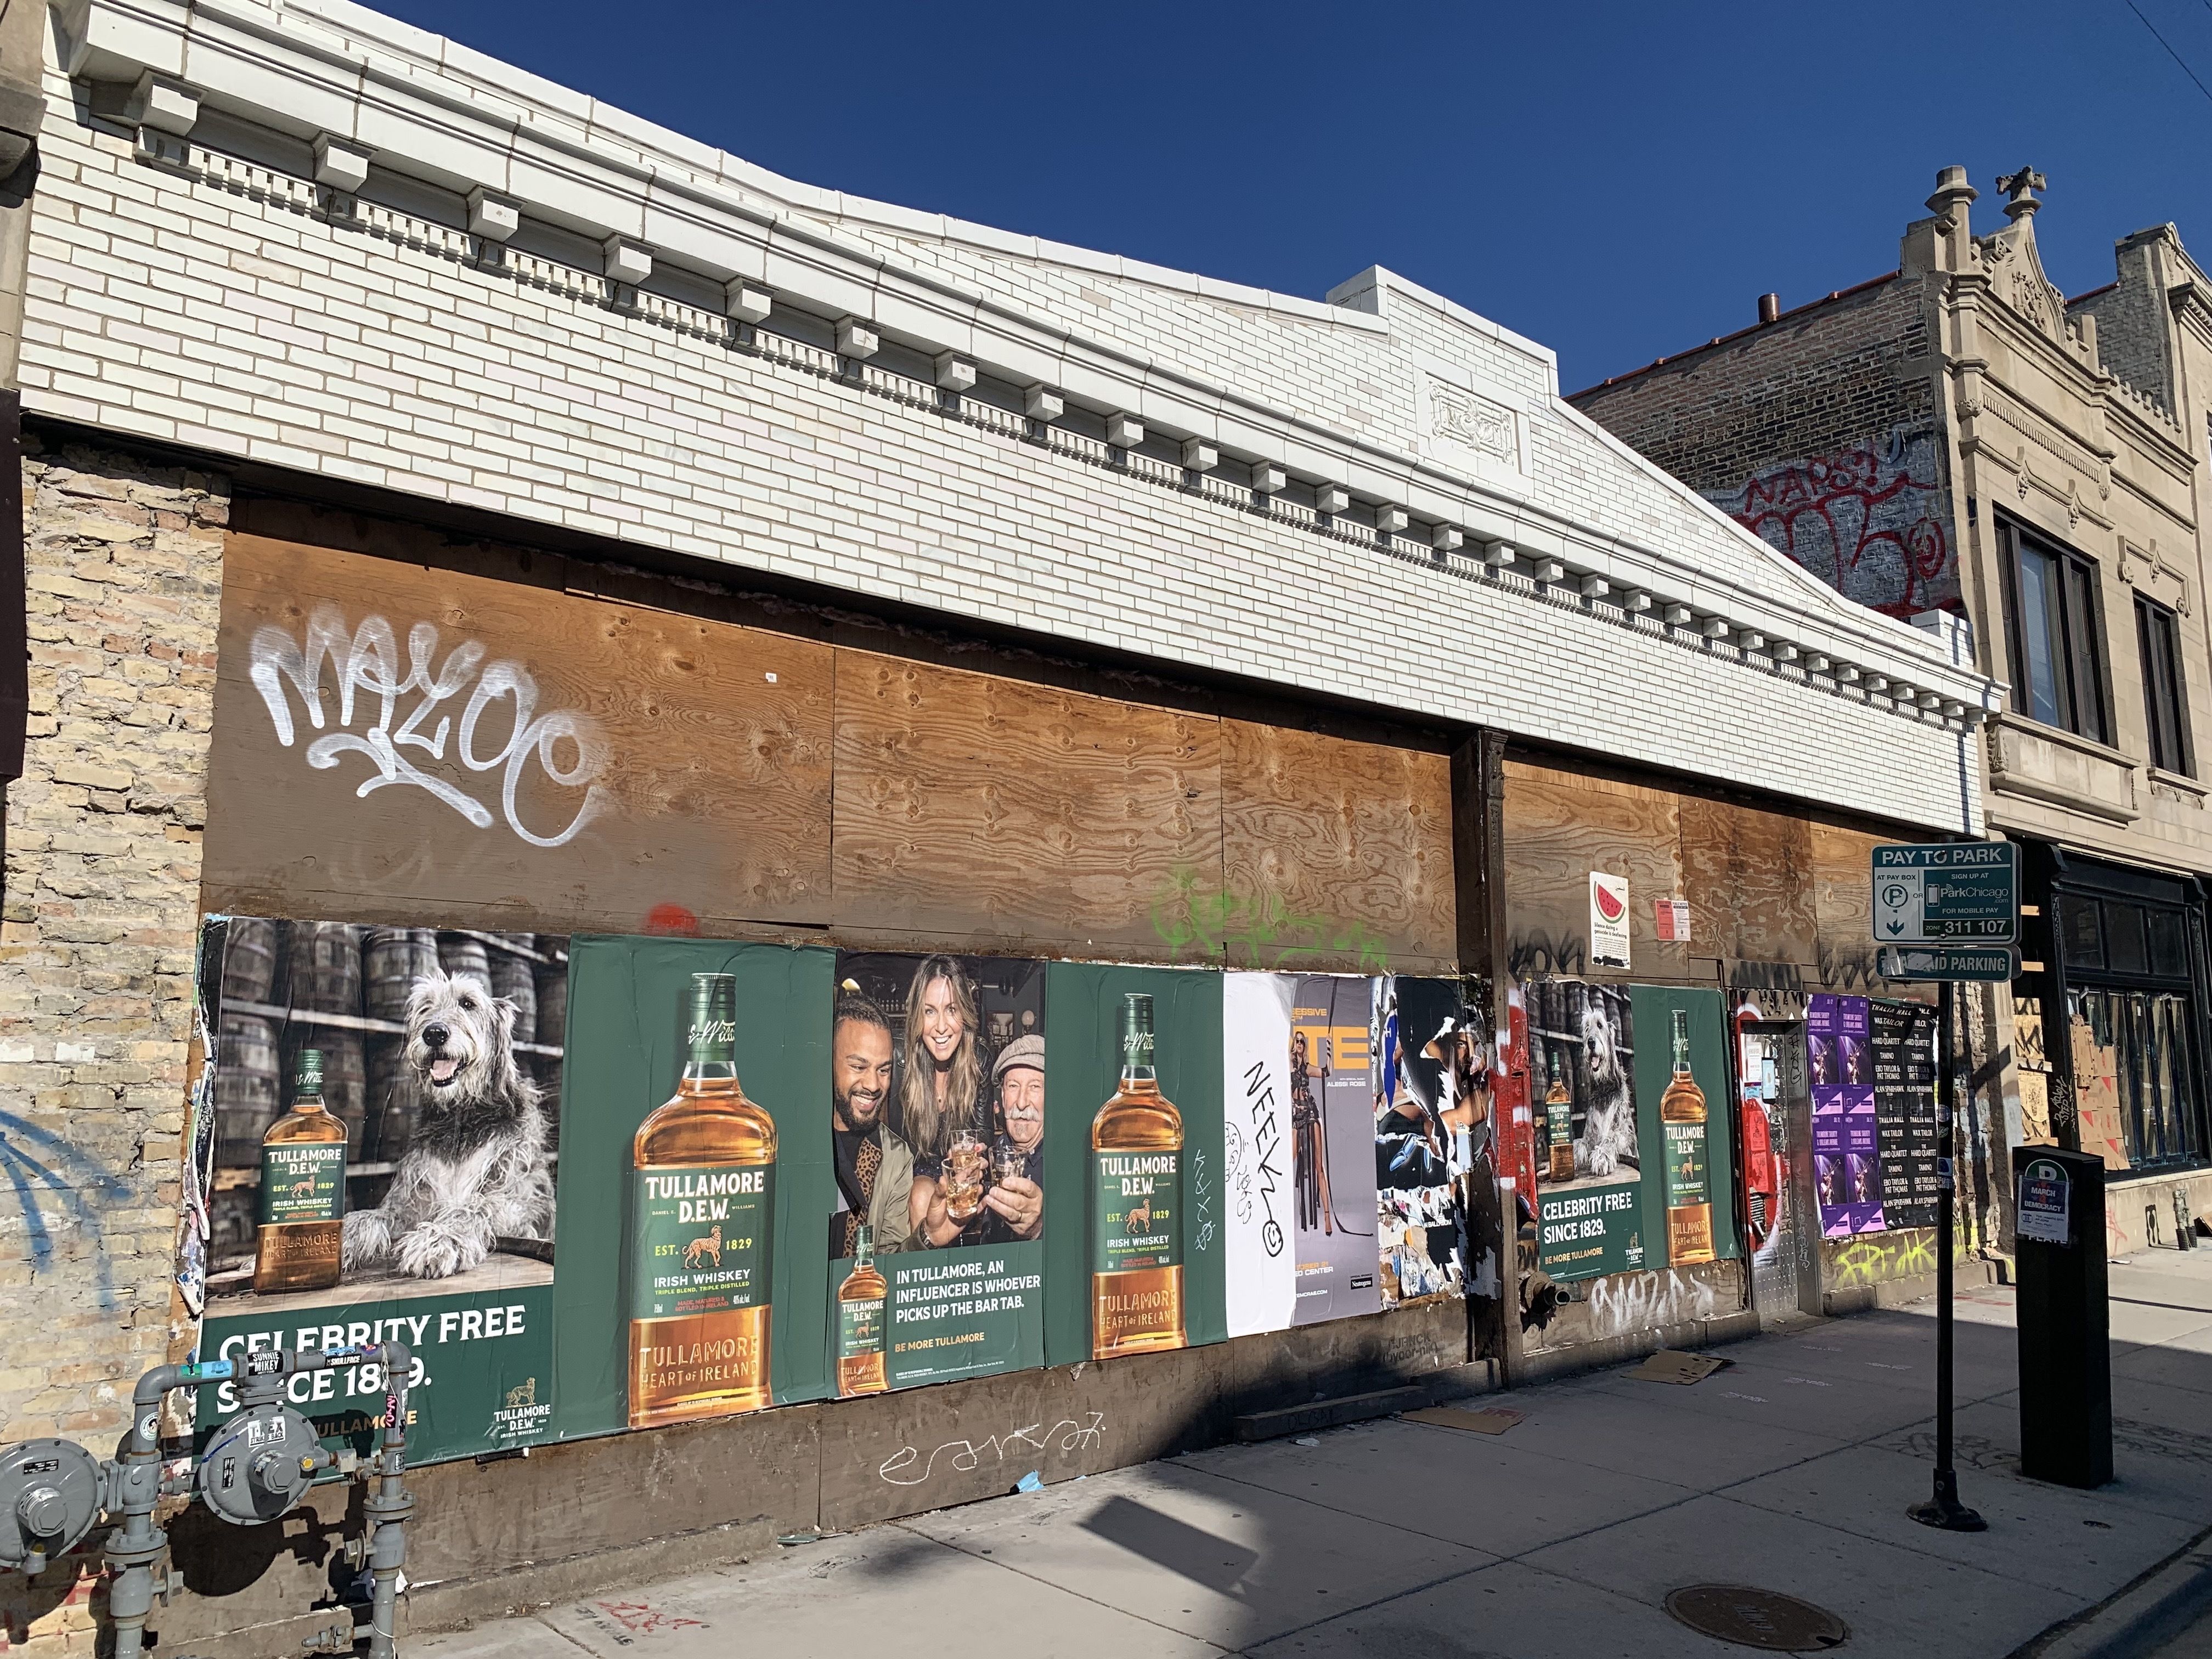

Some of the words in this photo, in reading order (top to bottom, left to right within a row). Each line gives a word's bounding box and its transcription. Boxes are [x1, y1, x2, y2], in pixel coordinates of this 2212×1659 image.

[1882, 851, 1916, 864] PAY
[1921, 850, 1947, 864] TO
[1953, 848, 2001, 864] PARK
[1940, 887, 2008, 899] ParkChicago
[1945, 922, 1971, 933] 311
[1978, 921, 2006, 933] 107
[1951, 957, 2006, 972] PARKING
[1872, 1005, 1895, 1013] THALIA
[1883, 1018, 1904, 1028] TAILOR
[1883, 1037, 1901, 1046] QUARTET
[1548, 1105, 1570, 1114] TULLAMORE
[1666, 1126, 1705, 1141] TULLAMORE
[1677, 1141, 1695, 1154] D.E.W.
[1891, 1149, 1907, 1158] QUARTET
[1922, 1149, 1936, 1158] QUARTET
[269, 1149, 342, 1163] TULLAMORE
[289, 1162, 321, 1175] D.E.W.
[1100, 1156, 1176, 1176] TULLAMORE
[645, 1171, 764, 1199] TULLAMORE
[1122, 1177, 1155, 1196] D.E.W.
[1685, 1181, 1704, 1190] WHISKEY
[2031, 1187, 2056, 1197] MARCH
[297, 1198, 332, 1206] WHISKEY
[1543, 1195, 1603, 1221] CELEBRITY
[1605, 1192, 1633, 1212] FREE
[2024, 1200, 2061, 1211] DEMOCRACY
[678, 1198, 731, 1223] D.E.W.
[1107, 1213, 1122, 1222] EST.
[1153, 1210, 1169, 1220] 1829
[1544, 1222, 1578, 1244] SINCE
[1579, 1218, 1606, 1238] 1829.
[266, 1232, 337, 1250] TULLAMORE
[655, 1245, 679, 1256] EST.
[726, 1238, 752, 1251] 1829
[1107, 1239, 1130, 1248] IRISH
[1132, 1234, 1170, 1246] WHISKEY
[300, 1242, 337, 1257] IRELAND
[1545, 1256, 1553, 1265] BE
[1553, 1252, 1571, 1263] MORE
[1571, 1246, 1604, 1260] TULLAMORE
[896, 1269, 910, 1284] IN
[912, 1262, 985, 1283] TULLAMORE,
[987, 1260, 1004, 1274] AN
[1305, 1266, 1334, 1276] CENTER
[654, 1275, 688, 1288] IRISH
[693, 1269, 751, 1285] WHISKEY
[720, 1281, 750, 1290] DISTILLED
[896, 1284, 969, 1304] INFLUENCER
[972, 1282, 983, 1295] IS
[985, 1275, 1041, 1293] WHOEVER
[842, 1300, 884, 1313] TULLAMORE
[1099, 1289, 1176, 1313] TULLAMORE
[896, 1306, 931, 1323] PICKS
[933, 1304, 948, 1318] UP
[950, 1301, 973, 1316] THE
[975, 1298, 998, 1313] BAR
[1000, 1295, 1024, 1309] TAB.
[854, 1311, 872, 1322] D.E.W.
[1100, 1315, 1128, 1330] HEART
[1138, 1310, 1177, 1326] IRELAND
[438, 1305, 526, 1344] FREE
[895, 1343, 906, 1353] BE
[908, 1339, 933, 1351] MORE
[935, 1333, 985, 1347] TULLAMORE
[252, 1351, 280, 1362] SUNNIE
[639, 1335, 759, 1369] TULLAMORE
[254, 1359, 279, 1372] MIKEY
[330, 1356, 361, 1366] SKULLFACE
[641, 1370, 685, 1389] HEART
[699, 1360, 758, 1383] IRELAND
[217, 1368, 336, 1414] SCE
[344, 1357, 432, 1397] 189.
[494, 1404, 550, 1422] TULLAMORE
[315, 1410, 417, 1436] ULLAMOE
[510, 1418, 535, 1431] D.E.W.
[271, 1432, 284, 1441] BACK
[517, 1427, 543, 1436] WHISKEY
